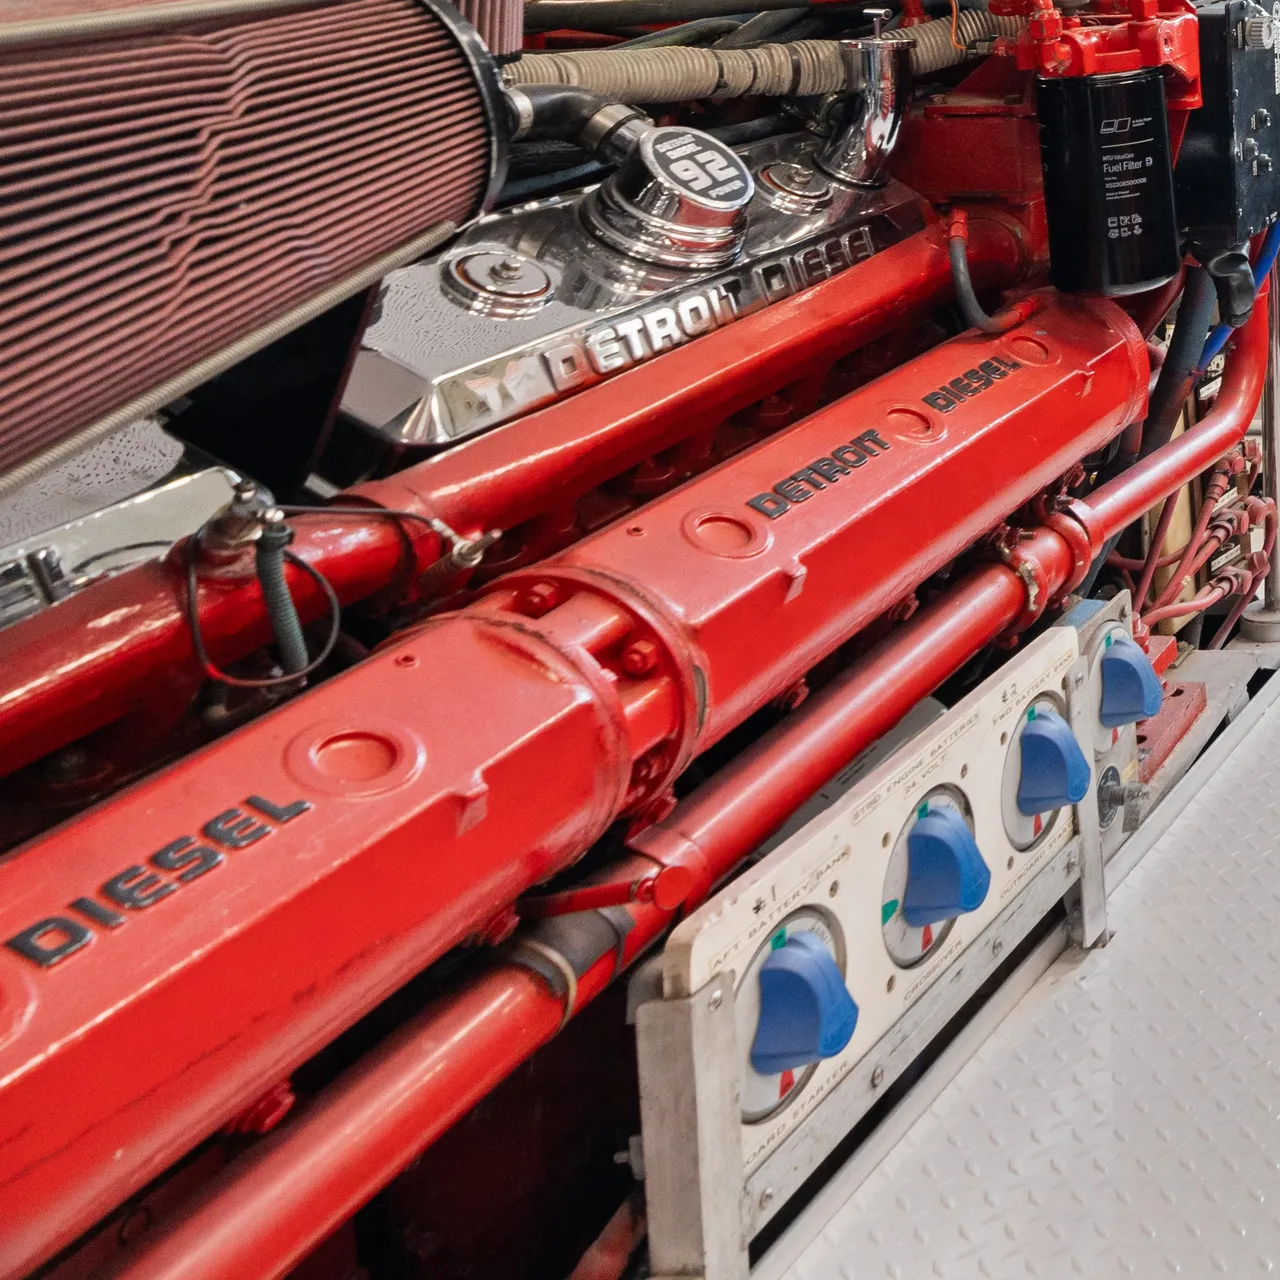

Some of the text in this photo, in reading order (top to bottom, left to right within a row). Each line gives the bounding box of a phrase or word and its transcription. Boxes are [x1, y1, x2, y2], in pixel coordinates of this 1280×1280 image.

[669, 149, 740, 192] 92
[1103, 159, 1142, 173] Fuel Filter
[542, 276, 743, 394] DETROIT
[921, 355, 1022, 414] DIESEL
[745, 427, 892, 520] DETROIT
[993, 707, 1013, 725] FWD
[1015, 672, 1051, 707] BATTERY
[853, 794, 882, 821] STBD
[886, 758, 925, 793] ENGINE
[930, 711, 980, 757] BATTERIES
[921, 753, 947, 779] VOLT
[1, 794, 315, 969] DIESEL
[1000, 850, 1046, 899] OUTBOARD
[713, 849, 849, 969] AFT BATTERY BANK
[904, 939, 962, 1001] CROSSOVER
[792, 1059, 848, 1120] STARTER
